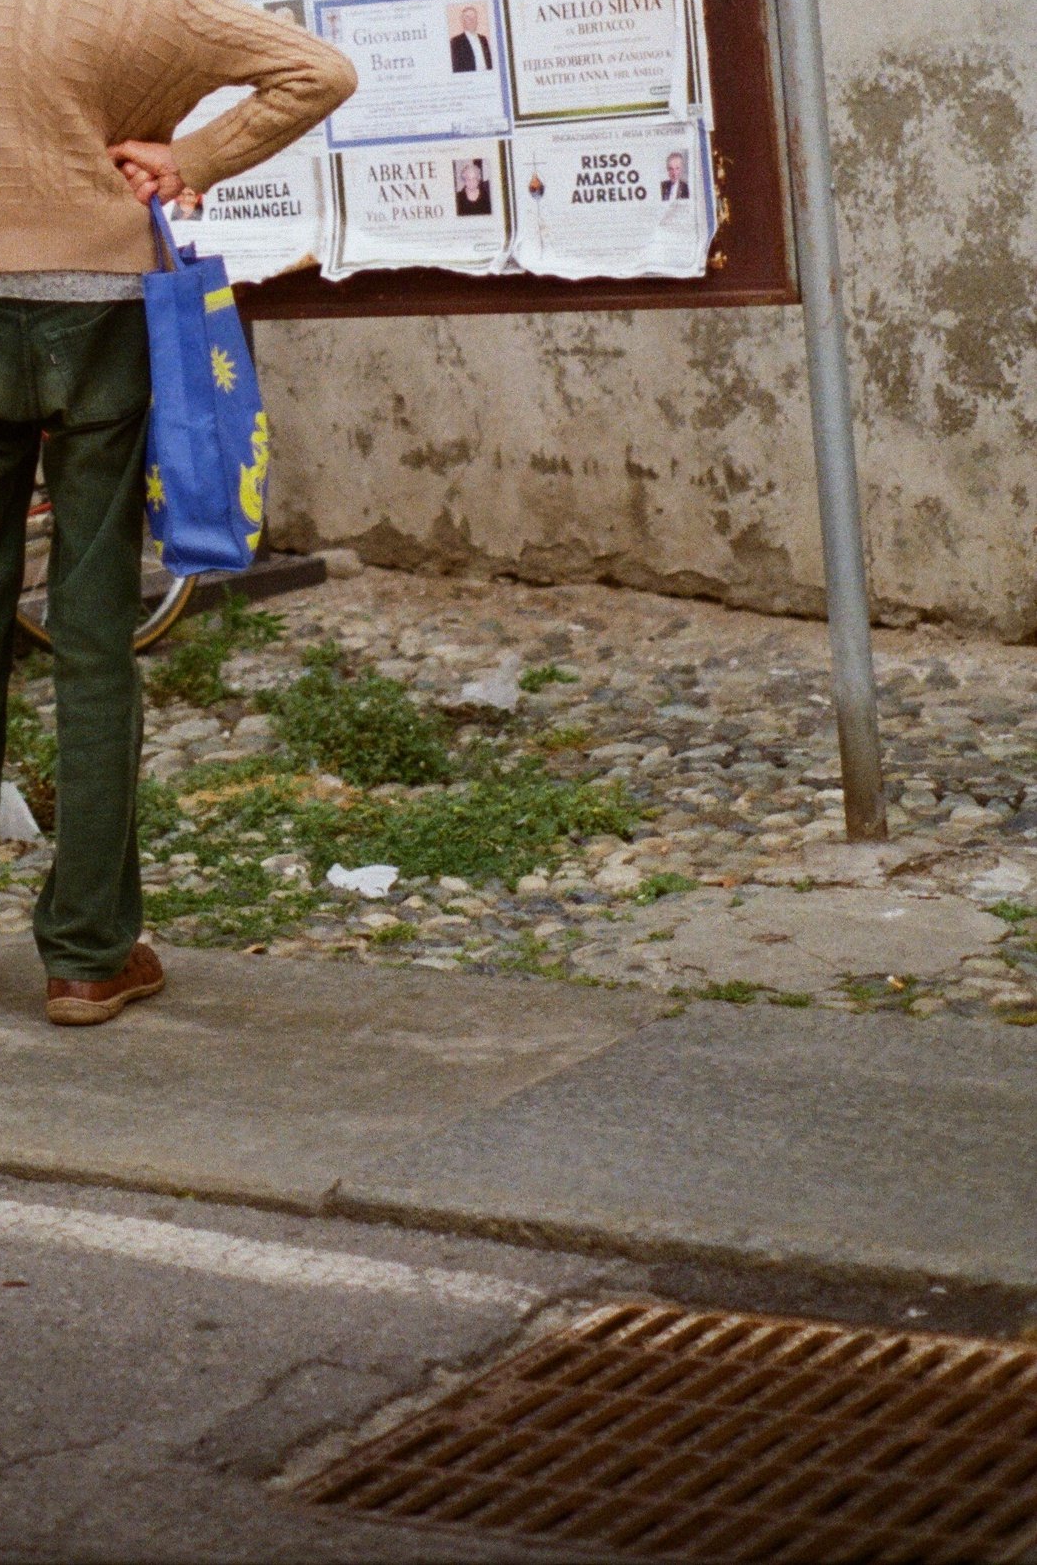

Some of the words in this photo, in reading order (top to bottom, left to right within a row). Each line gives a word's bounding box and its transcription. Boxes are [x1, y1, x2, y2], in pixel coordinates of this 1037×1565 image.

[536, 0, 603, 23] ANELLO
[353, 24, 428, 46] Giovanni
[371, 54, 415, 71] Barra
[556, 53, 604, 71] ROBERTA
[579, 70, 610, 83] ANNA
[581, 153, 631, 170] RISSO
[368, 161, 437, 183] ABRATE
[576, 169, 640, 187] MARCO
[218, 182, 291, 202] EMANUELA
[378, 183, 430, 203] ANNA
[571, 186, 647, 204] AURELIO
[209, 200, 302, 221] GIANNANGELI
[392, 205, 444, 220] PASERO
